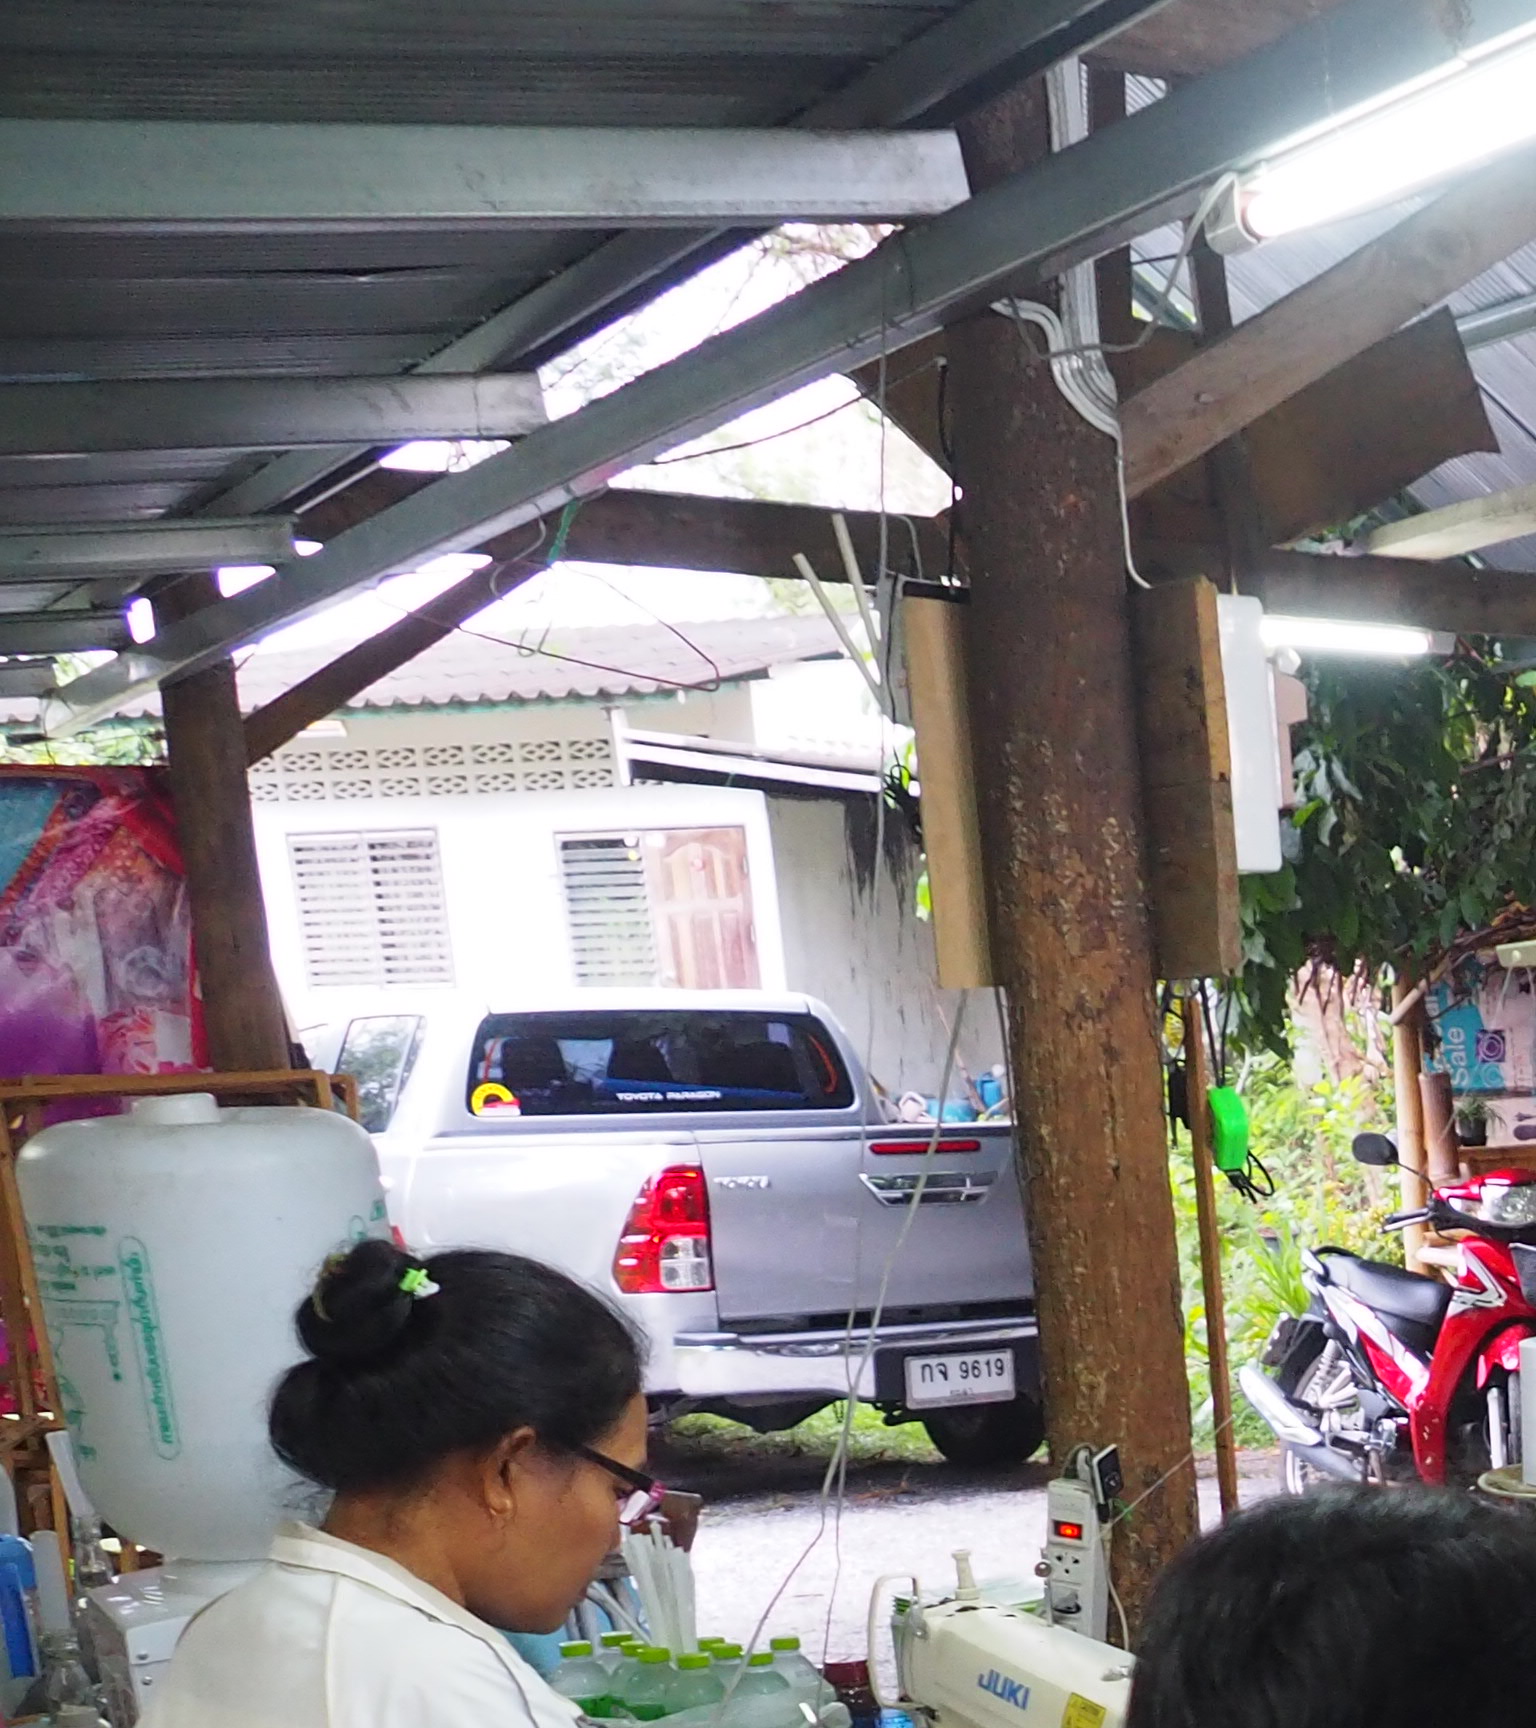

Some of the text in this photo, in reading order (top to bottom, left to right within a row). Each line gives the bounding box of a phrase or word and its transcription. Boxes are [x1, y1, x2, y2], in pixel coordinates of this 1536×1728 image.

[1443, 1026, 1470, 1087] Sale
[615, 1092, 664, 1101] TOYOTA
[921, 1358, 1005, 1383] กจ 9619
[977, 1668, 1030, 1711] JUKI
